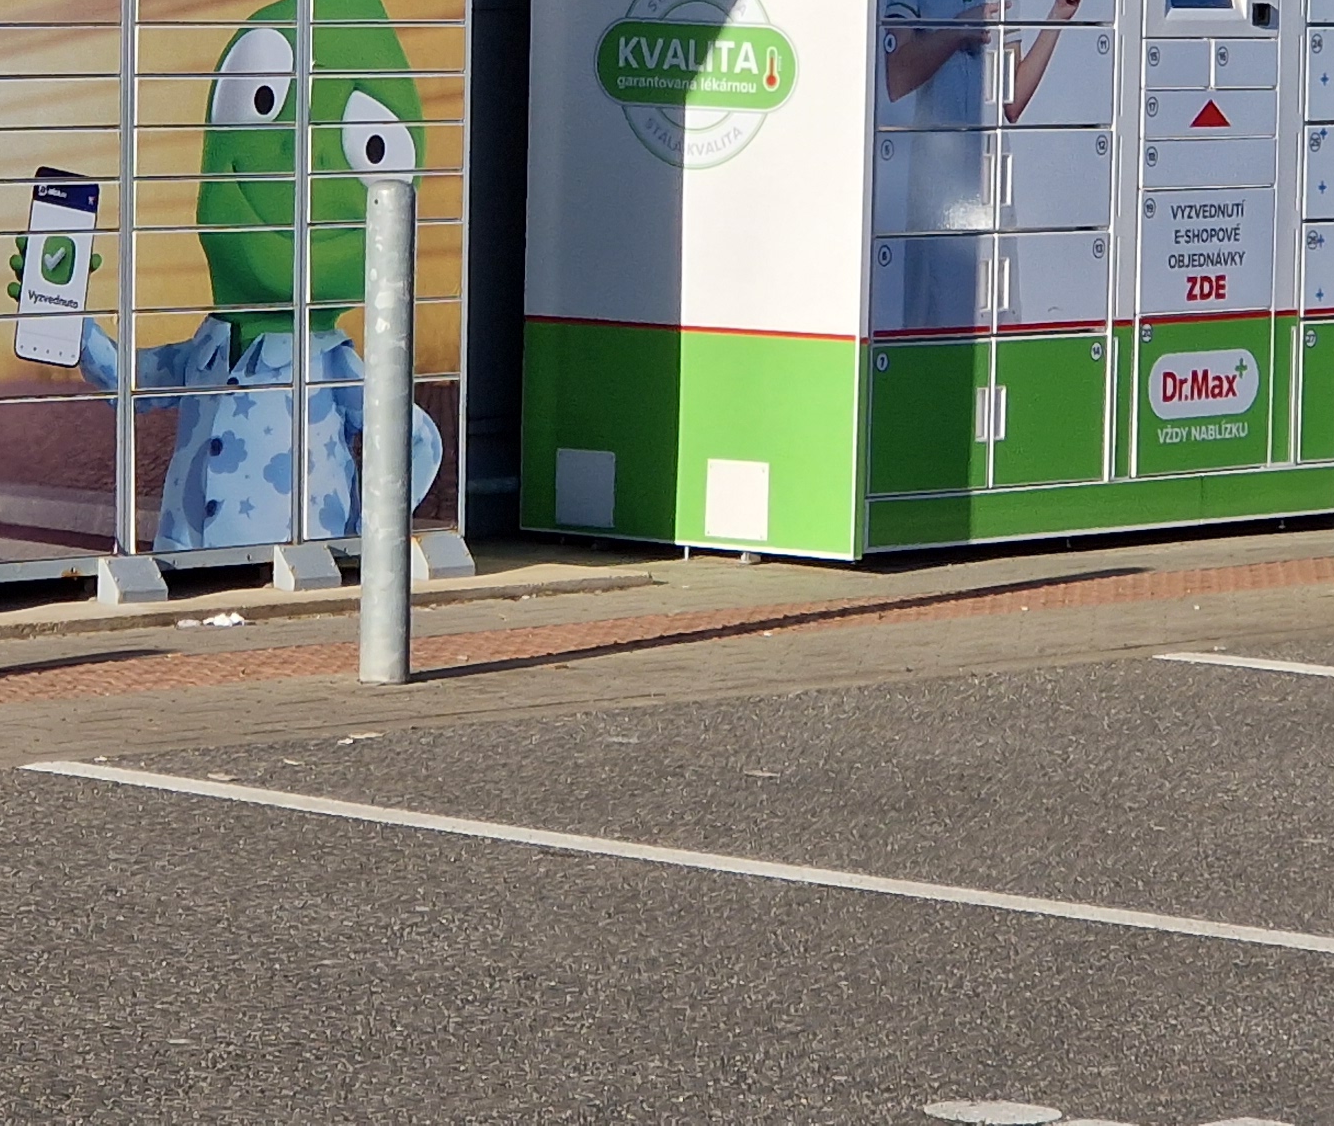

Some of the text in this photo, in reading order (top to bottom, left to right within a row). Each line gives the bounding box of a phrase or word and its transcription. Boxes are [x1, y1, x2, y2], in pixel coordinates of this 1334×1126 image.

[617, 36, 759, 75] KVALITA
[700, 76, 757, 94] lékárnou
[686, 126, 744, 157] KVALITA
[1170, 199, 1246, 221] VYZVEDNUTÍ
[1174, 223, 1241, 245] E-SHOPOVÉ
[1168, 247, 1246, 269] OBJEDNÁVKY
[1186, 274, 1227, 302] ZDE
[1157, 419, 1249, 444] VŽDY NABLÍZKU
